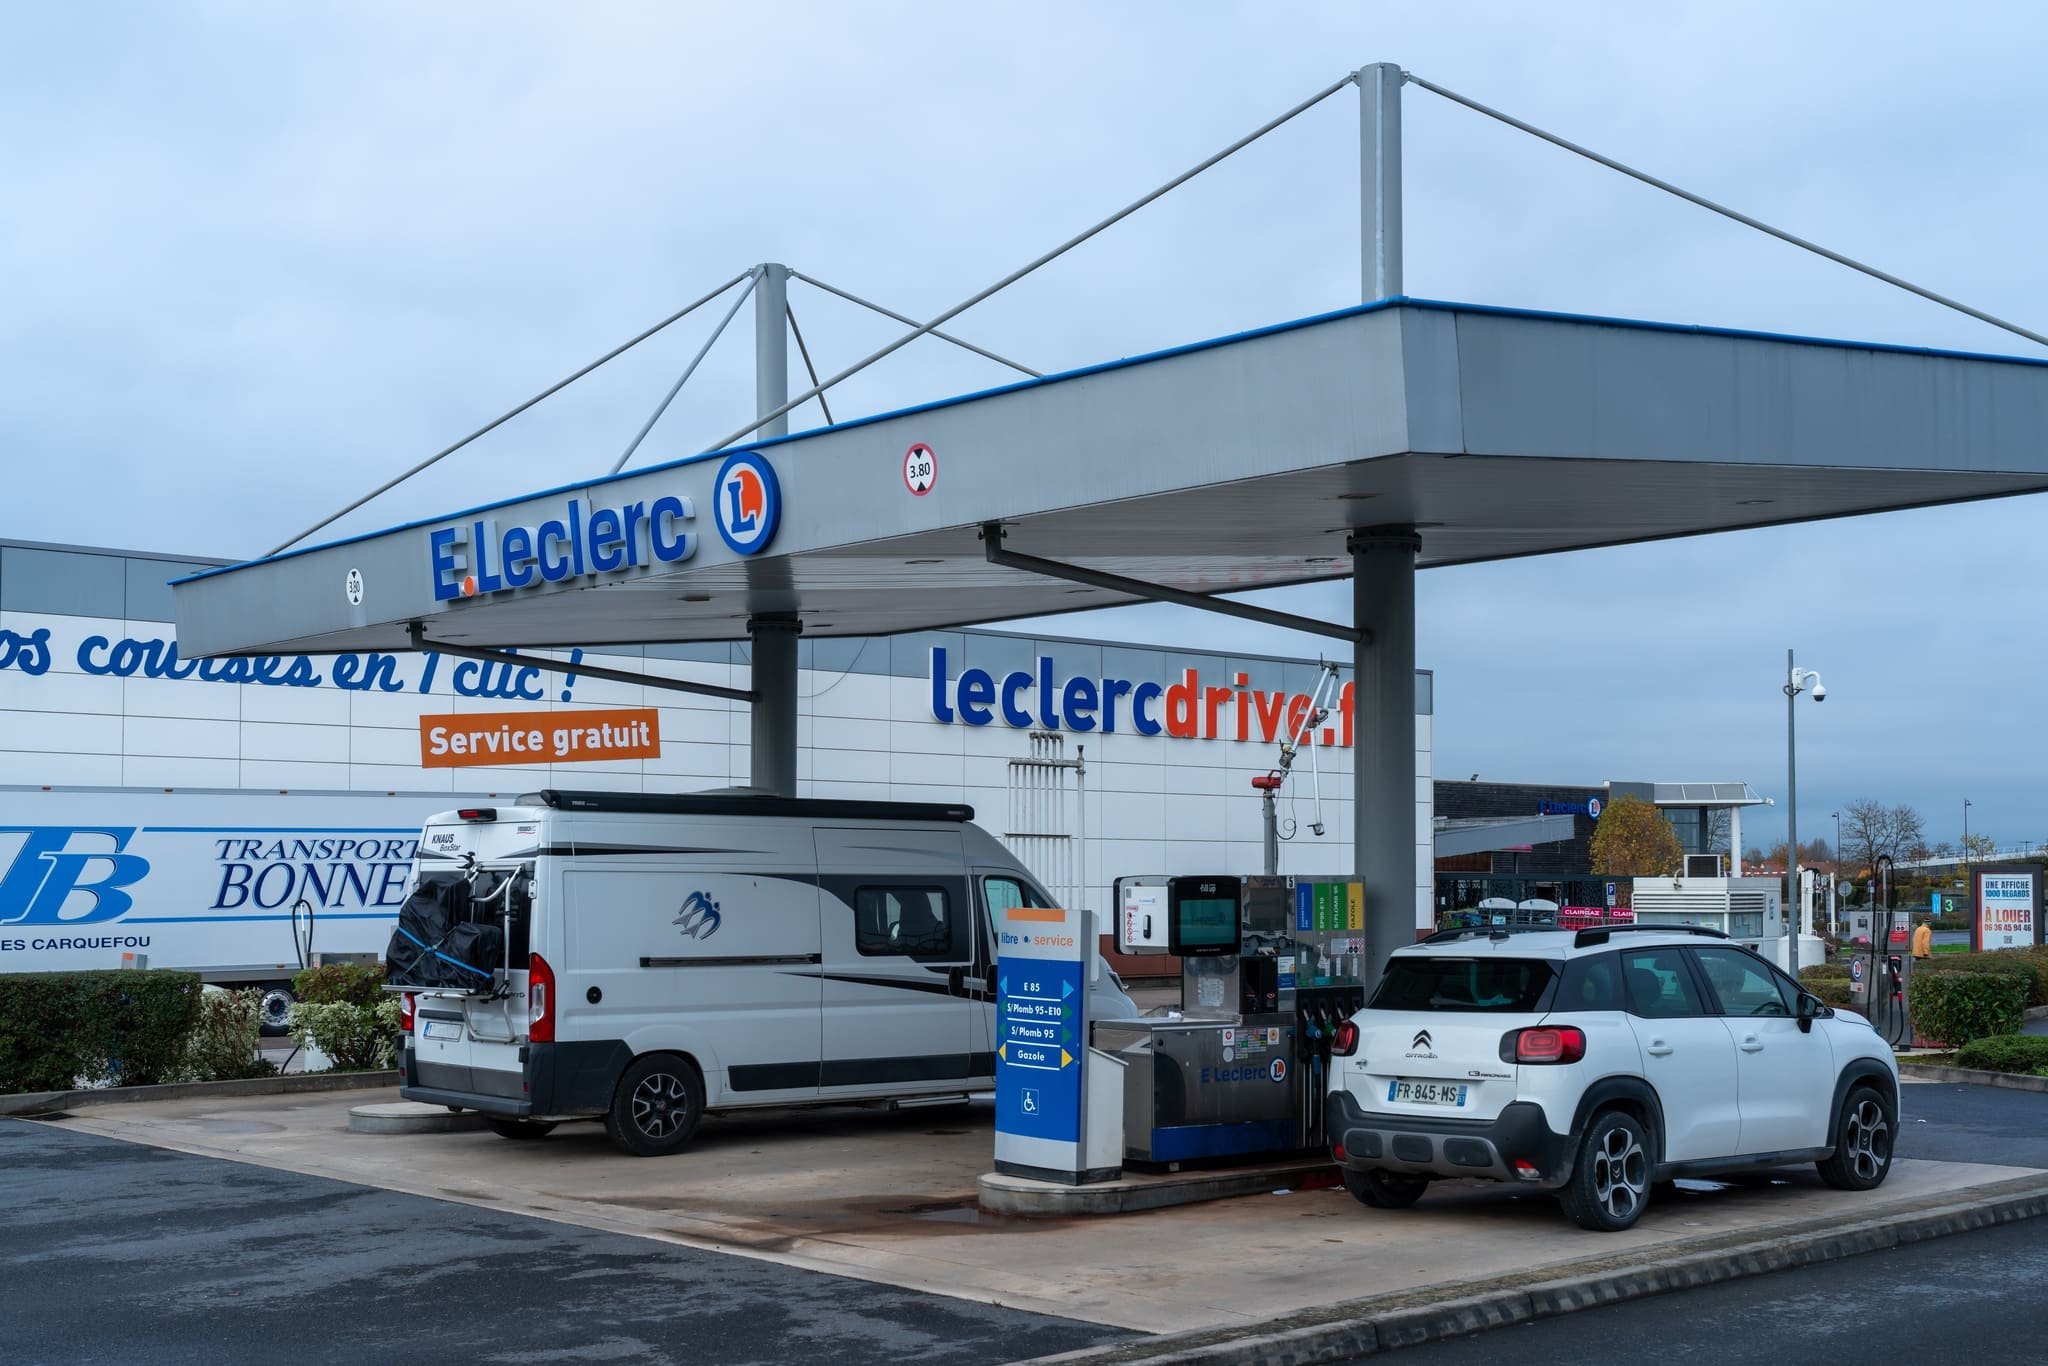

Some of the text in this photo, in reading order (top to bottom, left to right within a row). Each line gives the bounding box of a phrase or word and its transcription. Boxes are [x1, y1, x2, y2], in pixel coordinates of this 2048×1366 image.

[909, 462, 931, 479] 3.80
[430, 495, 698, 601] E.Leclerc
[332, 652, 404, 692] en
[429, 721, 650, 757] Service gratuit
[431, 834, 455, 844] KNAUS
[440, 843, 461, 852] BoxStar
[1288, 876, 1294, 888] 5
[1985, 880, 2030, 889] UNE AFFICHE
[1985, 890, 2030, 898] 1000 REGARDS
[1945, 899, 1953, 912] 3
[1564, 909, 1601, 918] CLAIRGAZ
[1985, 906, 2031, 923] À LOUER
[1984, 924, 2032, 932] 06 36 45 94 46
[31, 936, 151, 950] CARQUEFOU
[1001, 932, 1074, 947] libre service
[1023, 982, 1041, 992] E 85
[1043, 1029, 1055, 1039] 95
[1017, 1049, 1046, 1062] Gazole
[1395, 1081, 1458, 1103] FR-845-MS
